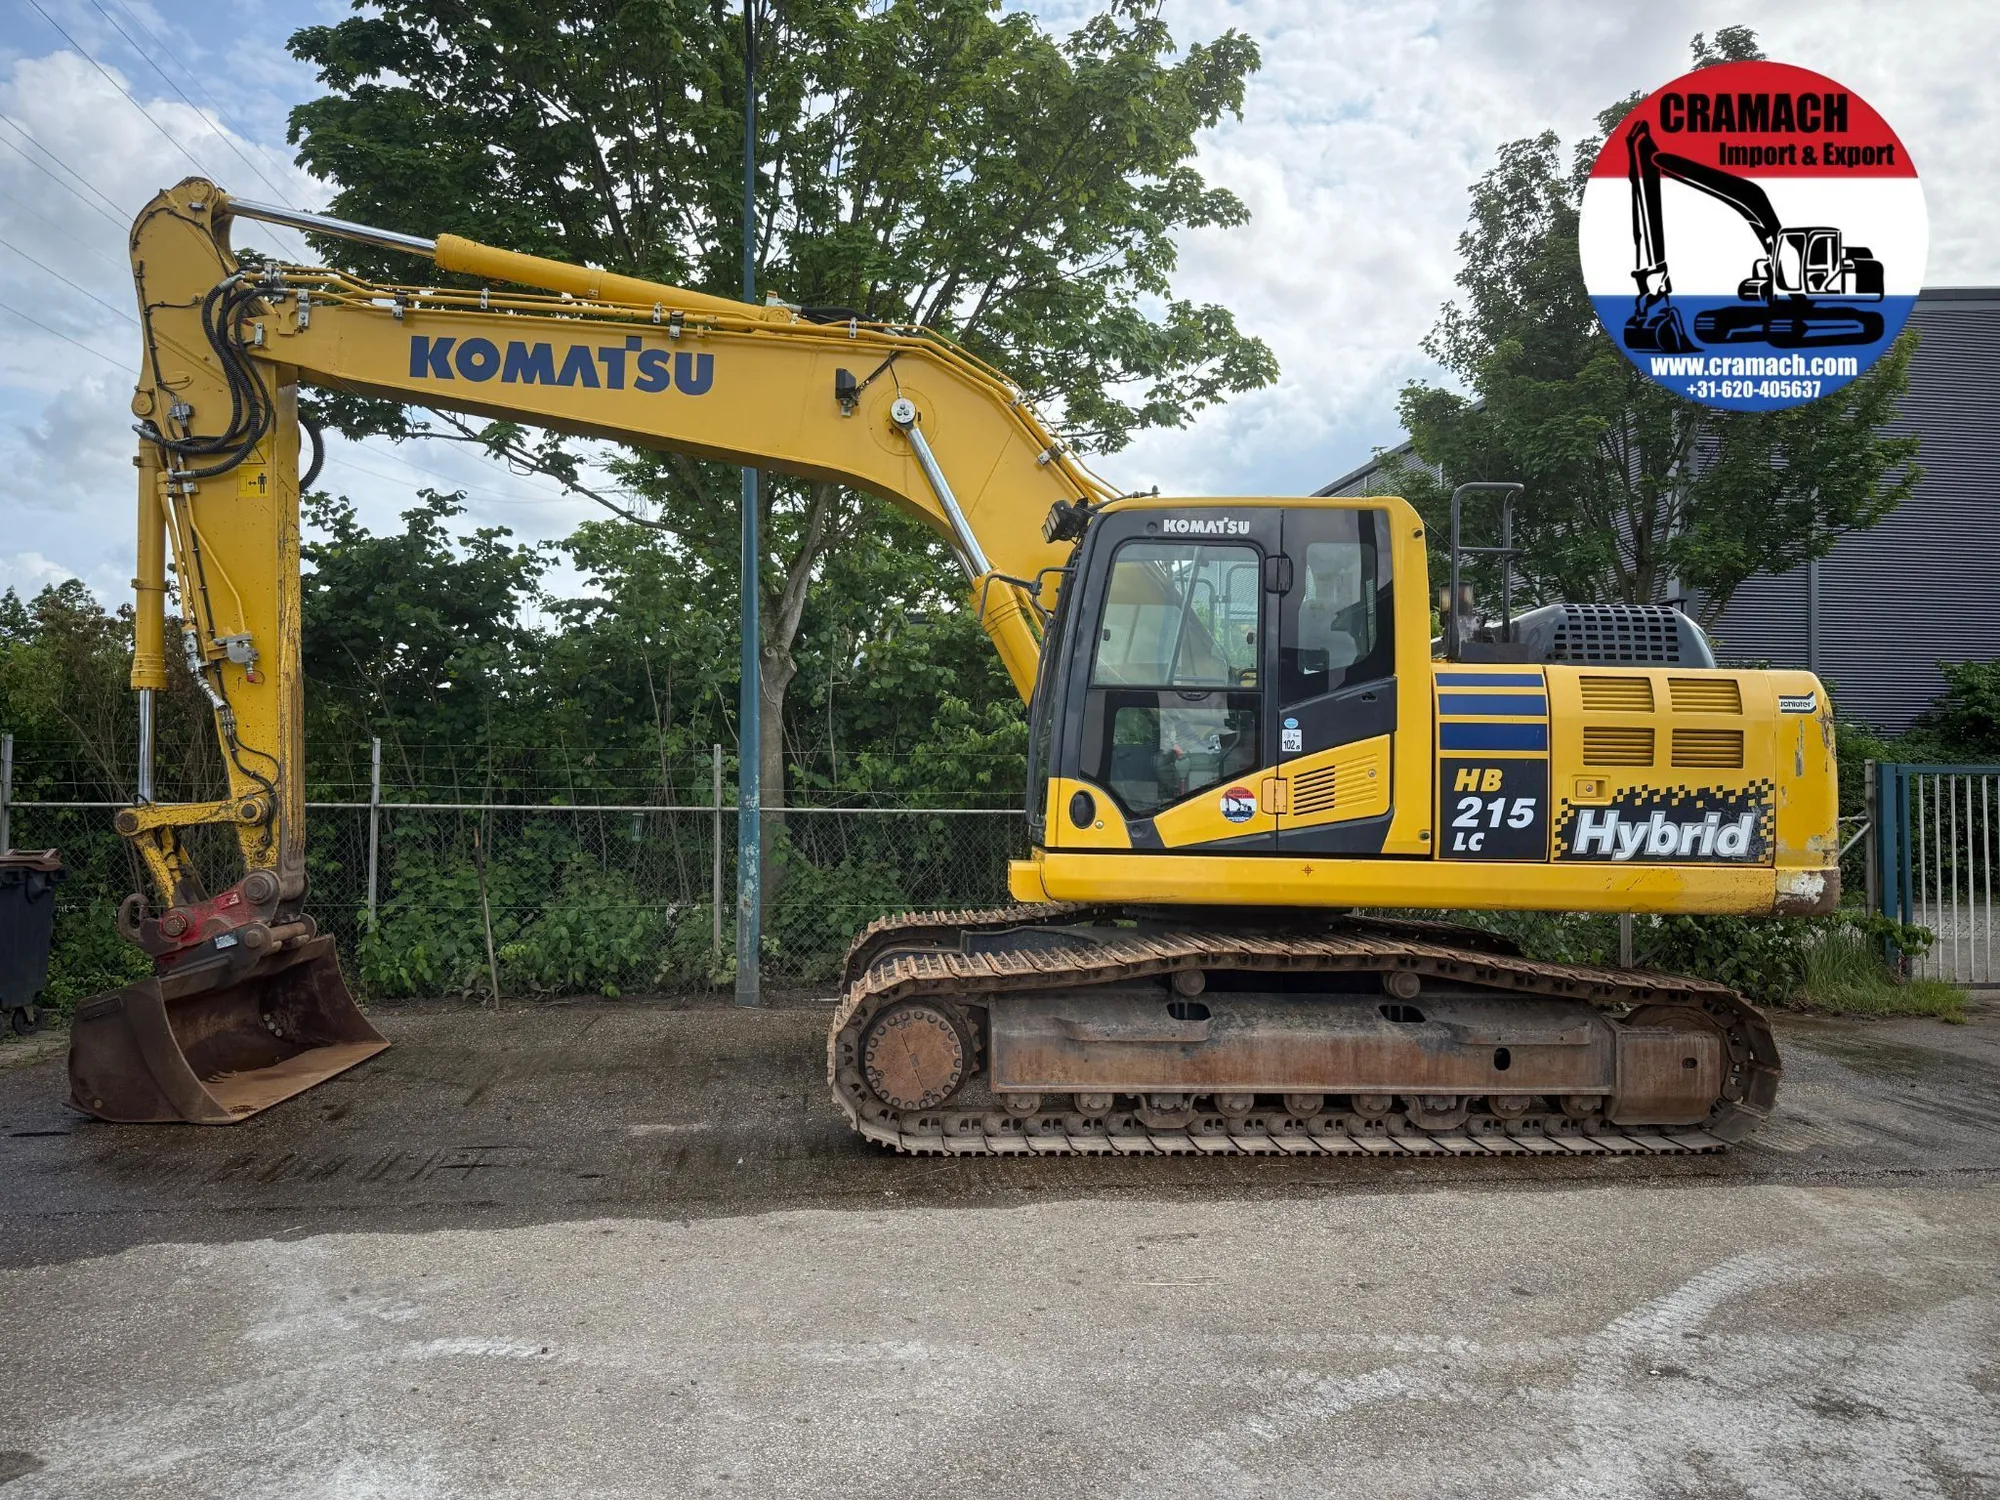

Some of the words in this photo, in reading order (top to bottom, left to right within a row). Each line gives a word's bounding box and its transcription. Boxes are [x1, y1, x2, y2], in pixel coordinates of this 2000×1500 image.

[409, 335, 715, 395] KOMATSU
[1163, 517, 1250, 535] KOMATSU
[1283, 739, 1296, 750] 102
[1453, 768, 1503, 792] HB
[1452, 797, 1537, 829] 215
[1452, 832, 1485, 852] LC
[1572, 809, 1757, 861] Hybrid
